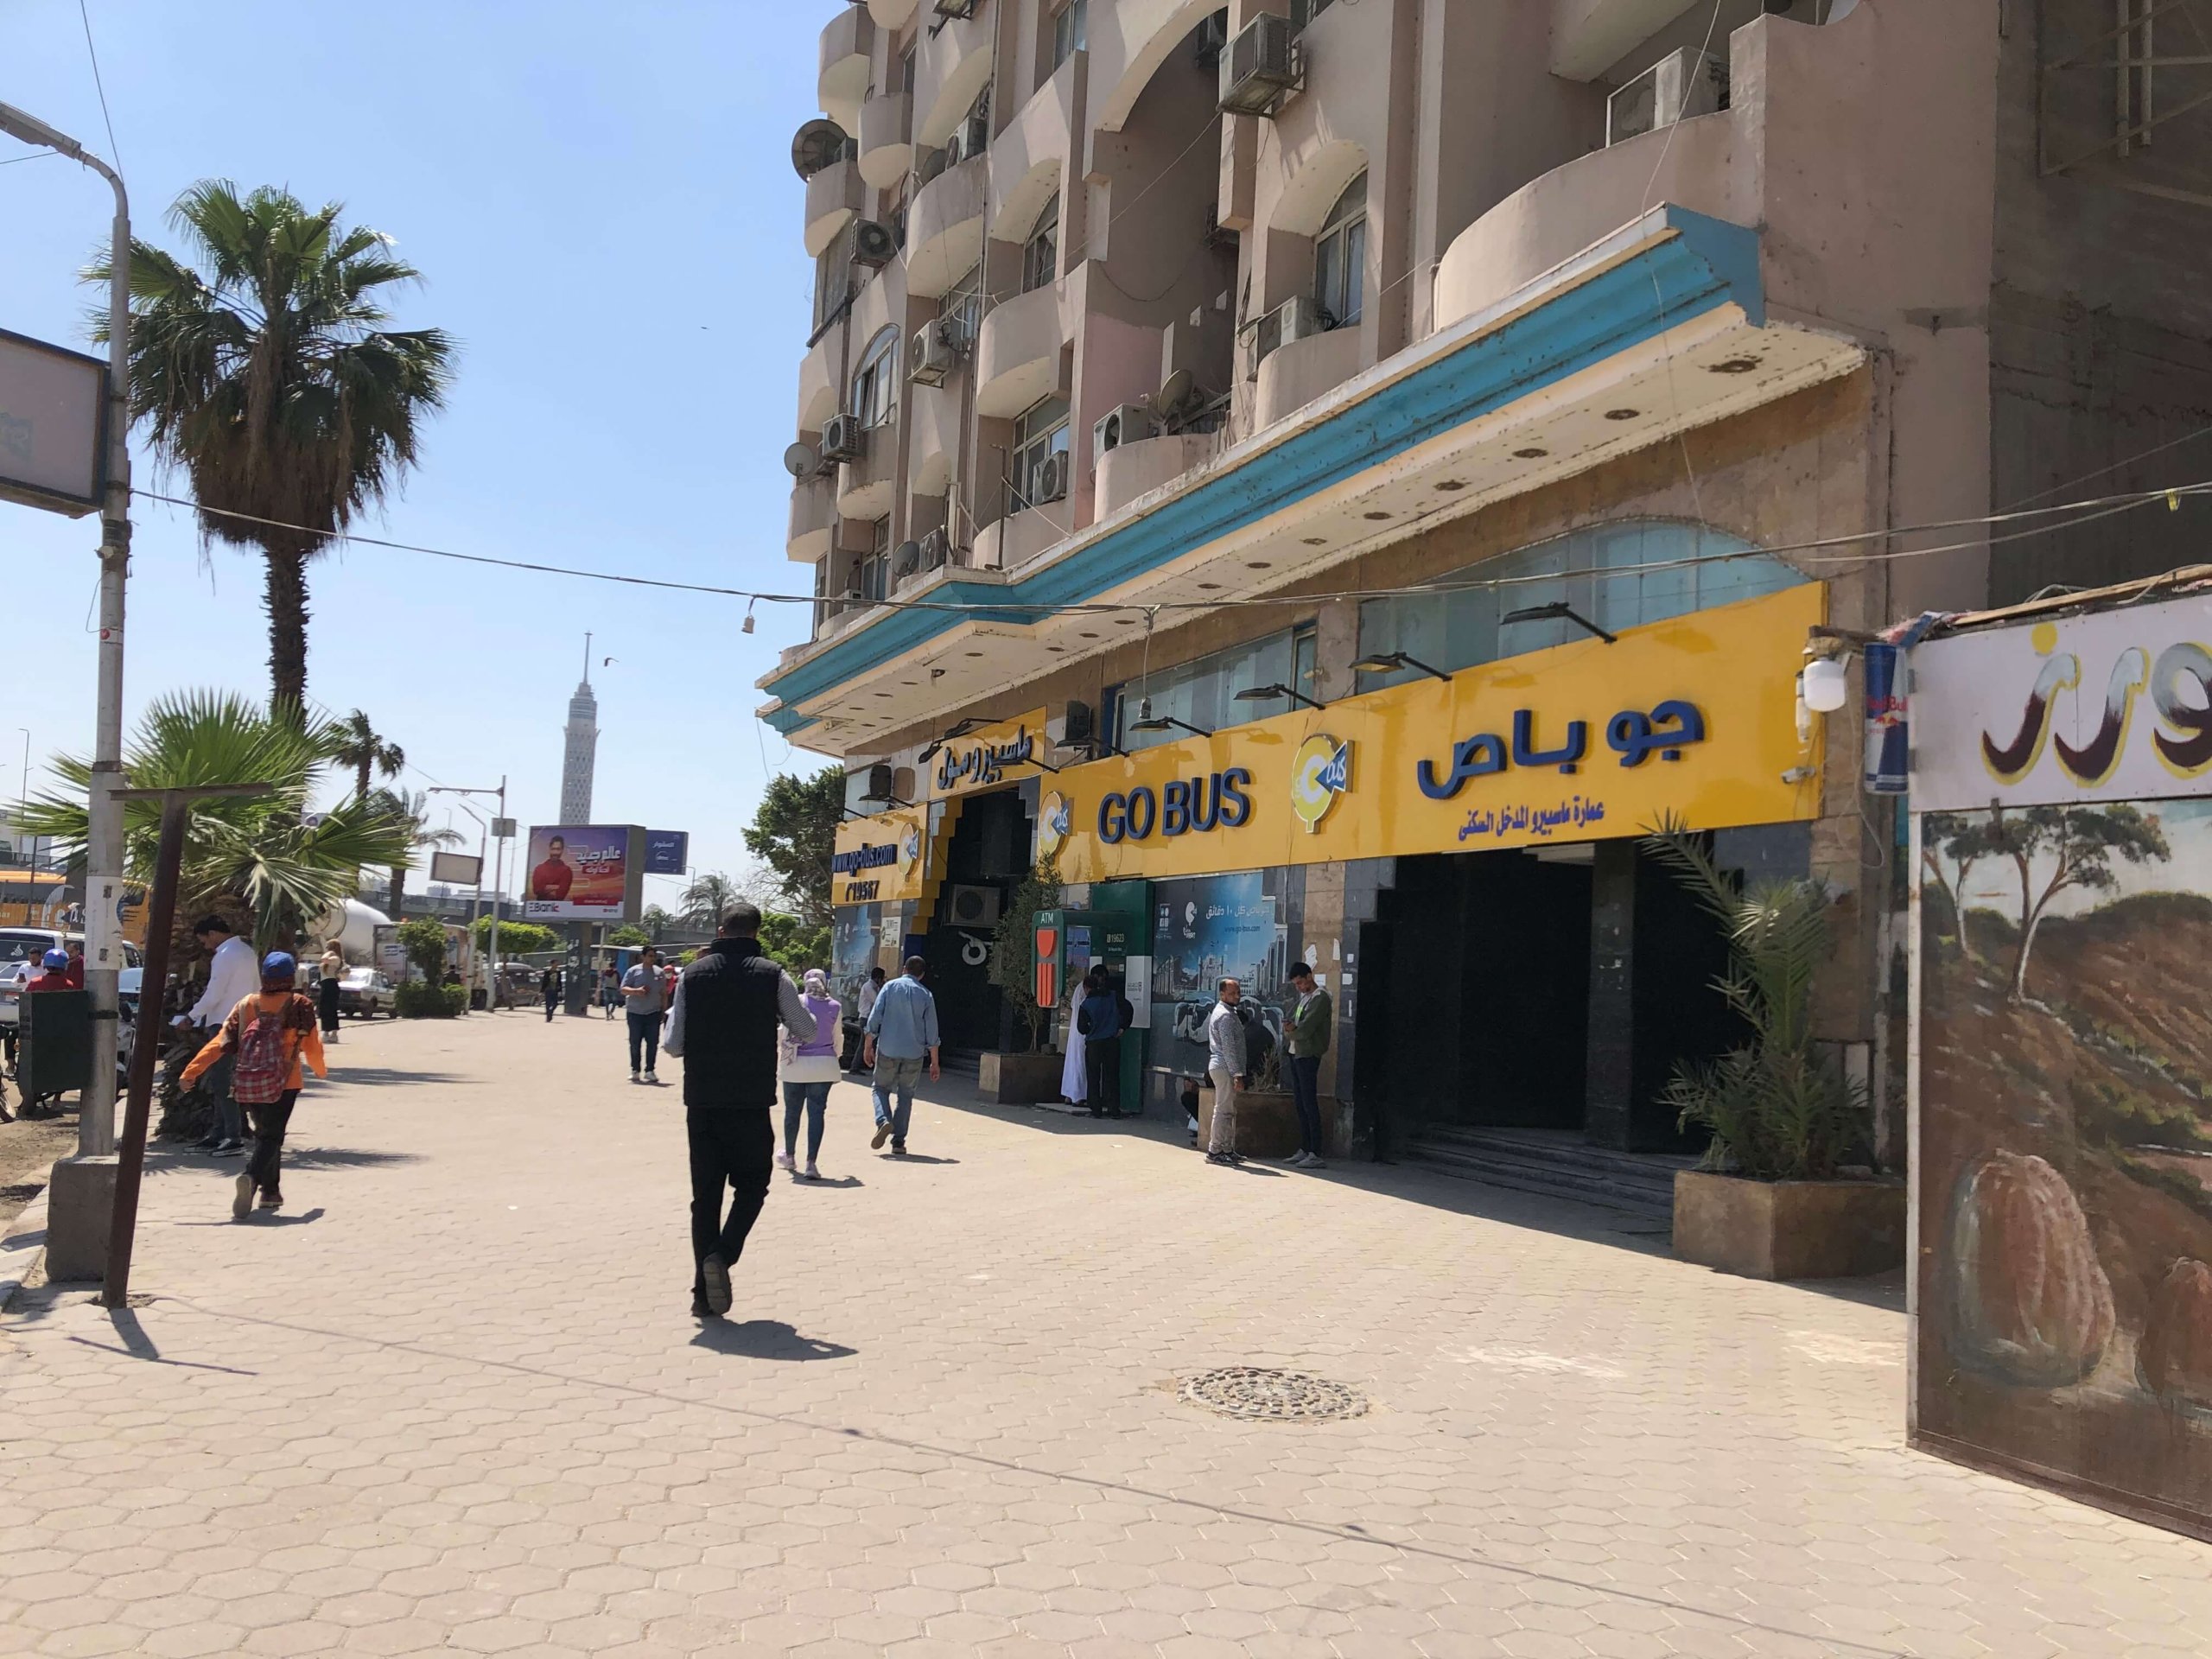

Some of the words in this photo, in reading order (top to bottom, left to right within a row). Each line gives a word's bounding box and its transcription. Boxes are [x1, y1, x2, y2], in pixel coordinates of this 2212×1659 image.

[1417, 709, 1587, 800] باص
[1606, 700, 1705, 767] جو
[1098, 786, 1156, 844] GO
[1162, 767, 1251, 836] BUS
[1497, 804, 1529, 837] المدخل
[1573, 795, 1605, 829] عمارة
[1040, 912, 1053, 924] ATM
